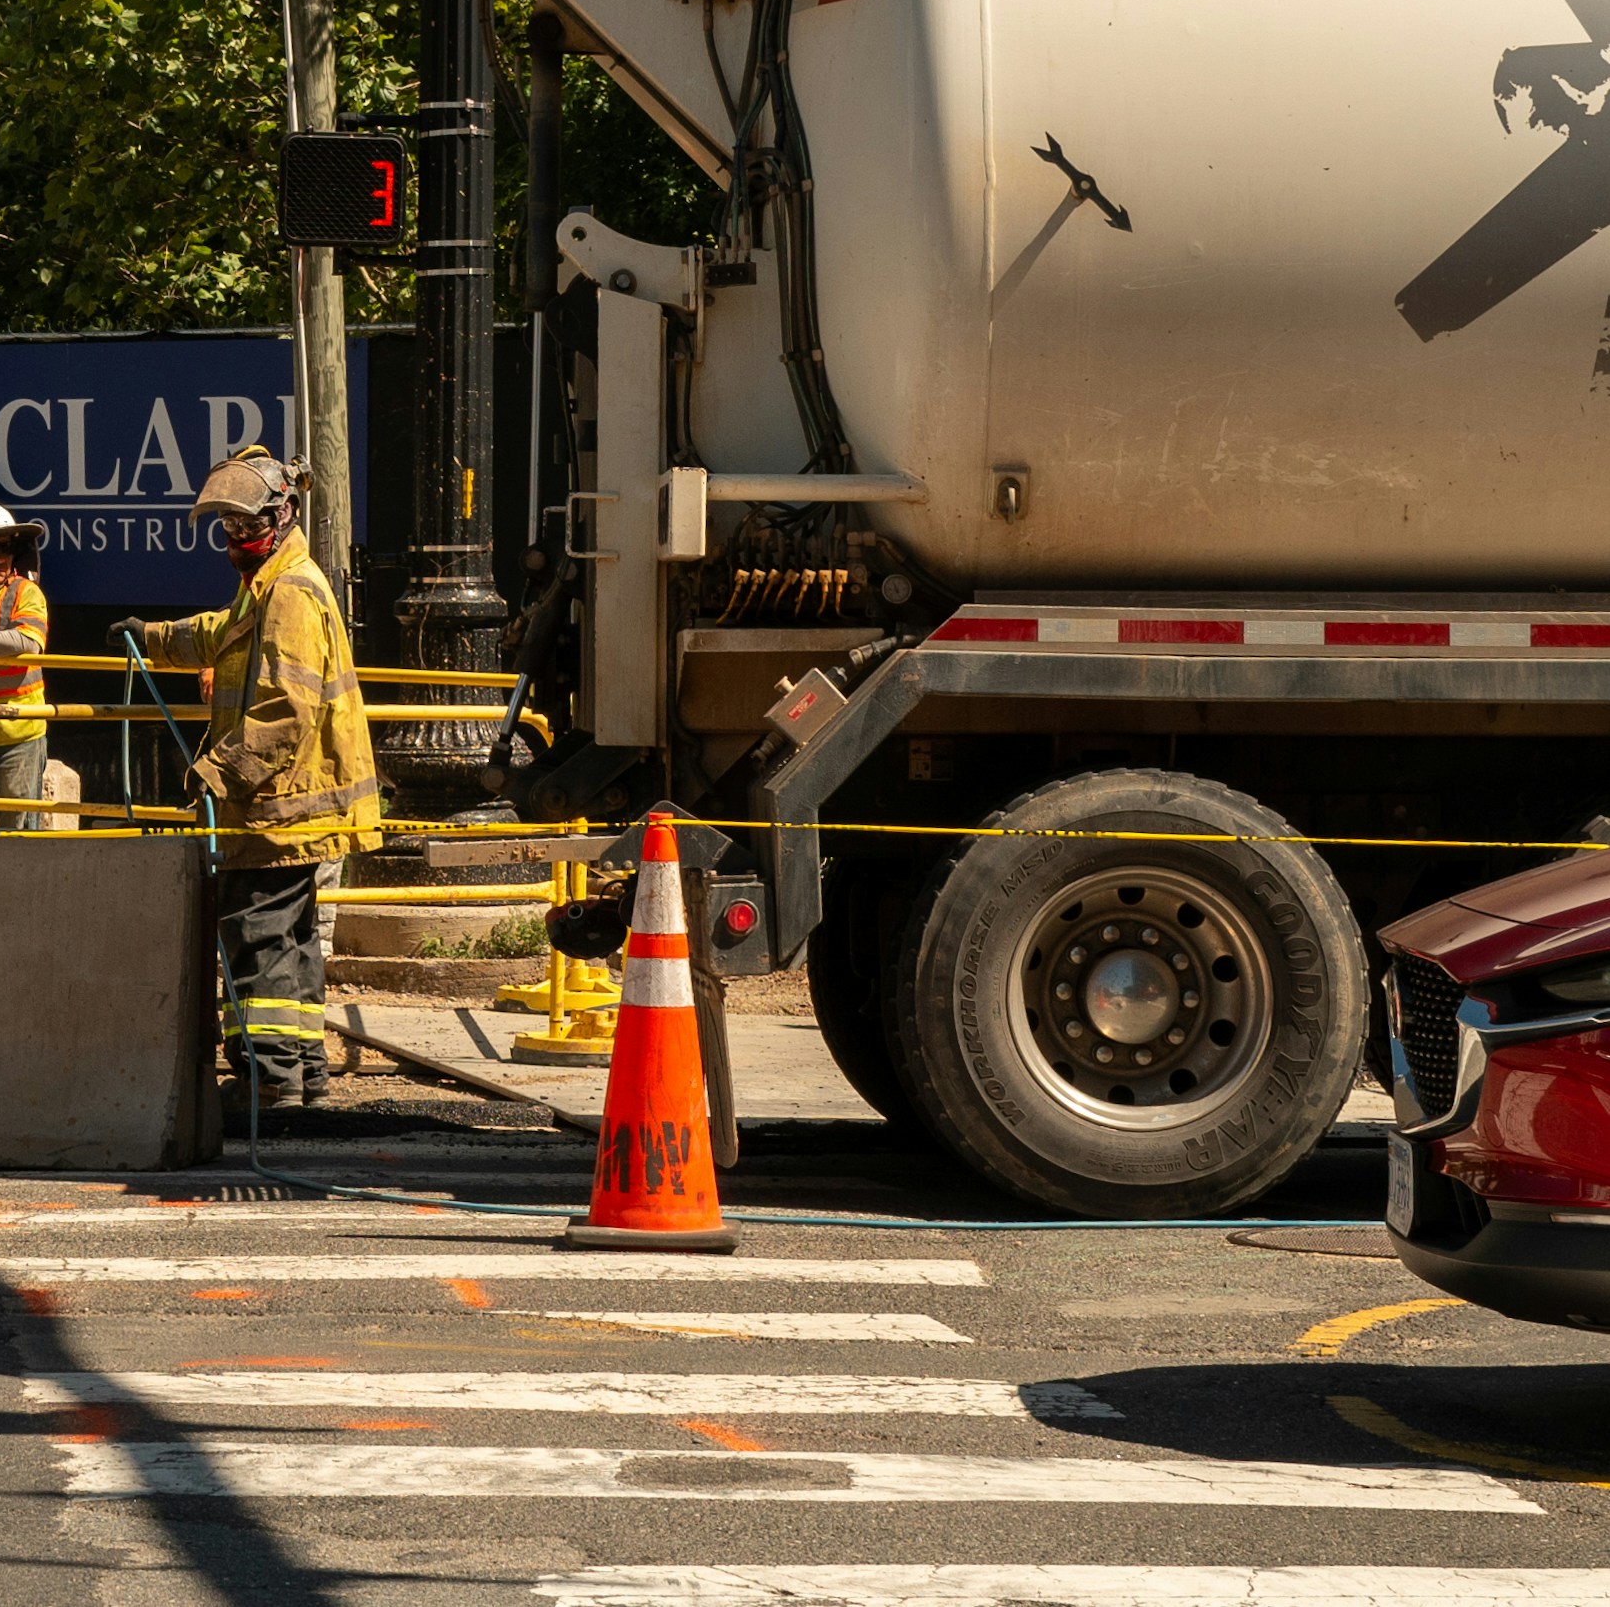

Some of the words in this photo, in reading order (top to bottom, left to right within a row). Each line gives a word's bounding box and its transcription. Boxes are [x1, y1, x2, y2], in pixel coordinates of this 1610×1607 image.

[369, 160, 395, 227] 3
[959, 900, 1027, 1127] WORKHORSE
[1000, 839, 1064, 898] MSD
[1182, 869, 1324, 1170] GOODYEAR
